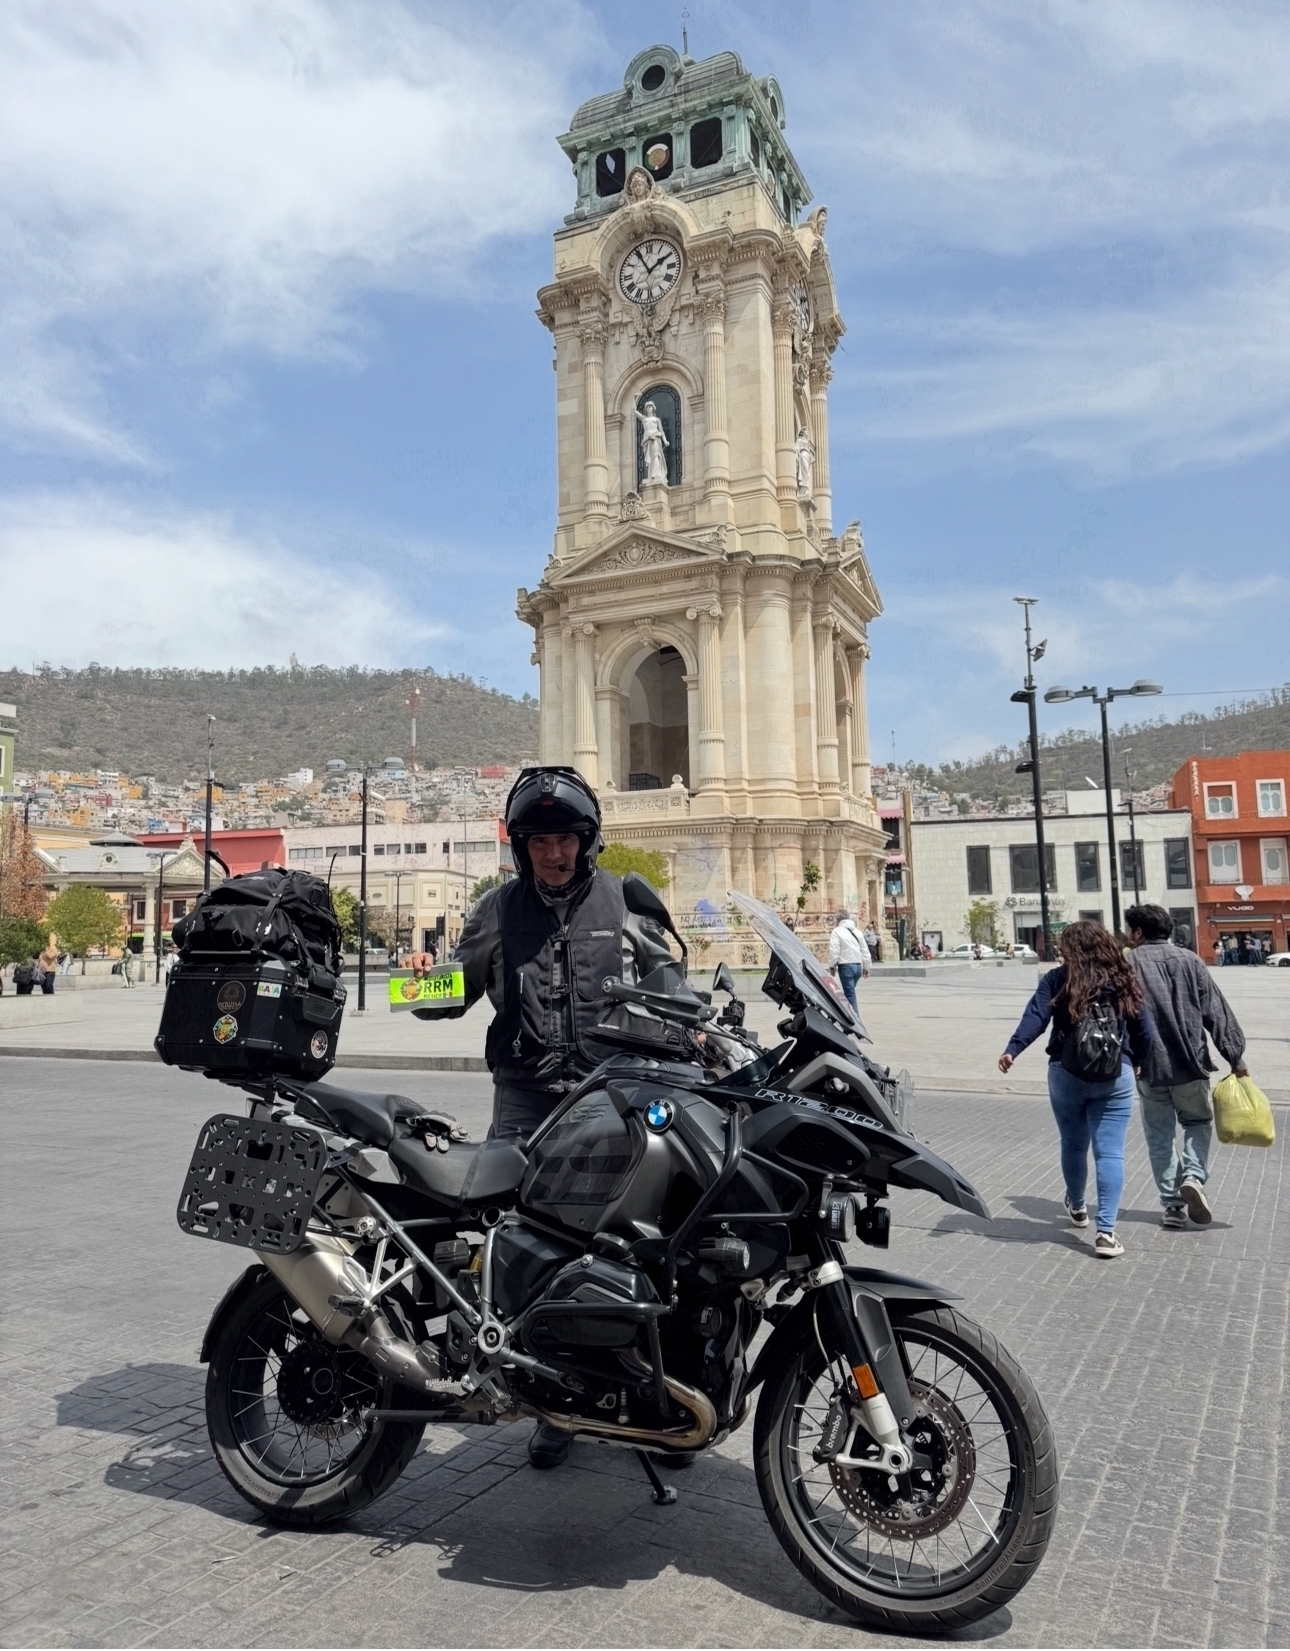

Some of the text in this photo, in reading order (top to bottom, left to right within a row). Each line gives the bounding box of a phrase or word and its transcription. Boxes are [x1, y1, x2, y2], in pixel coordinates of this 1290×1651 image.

[424, 978, 453, 993] RRM
[650, 1100, 672, 1113] BMW
[825, 1415, 841, 1449] brembo
